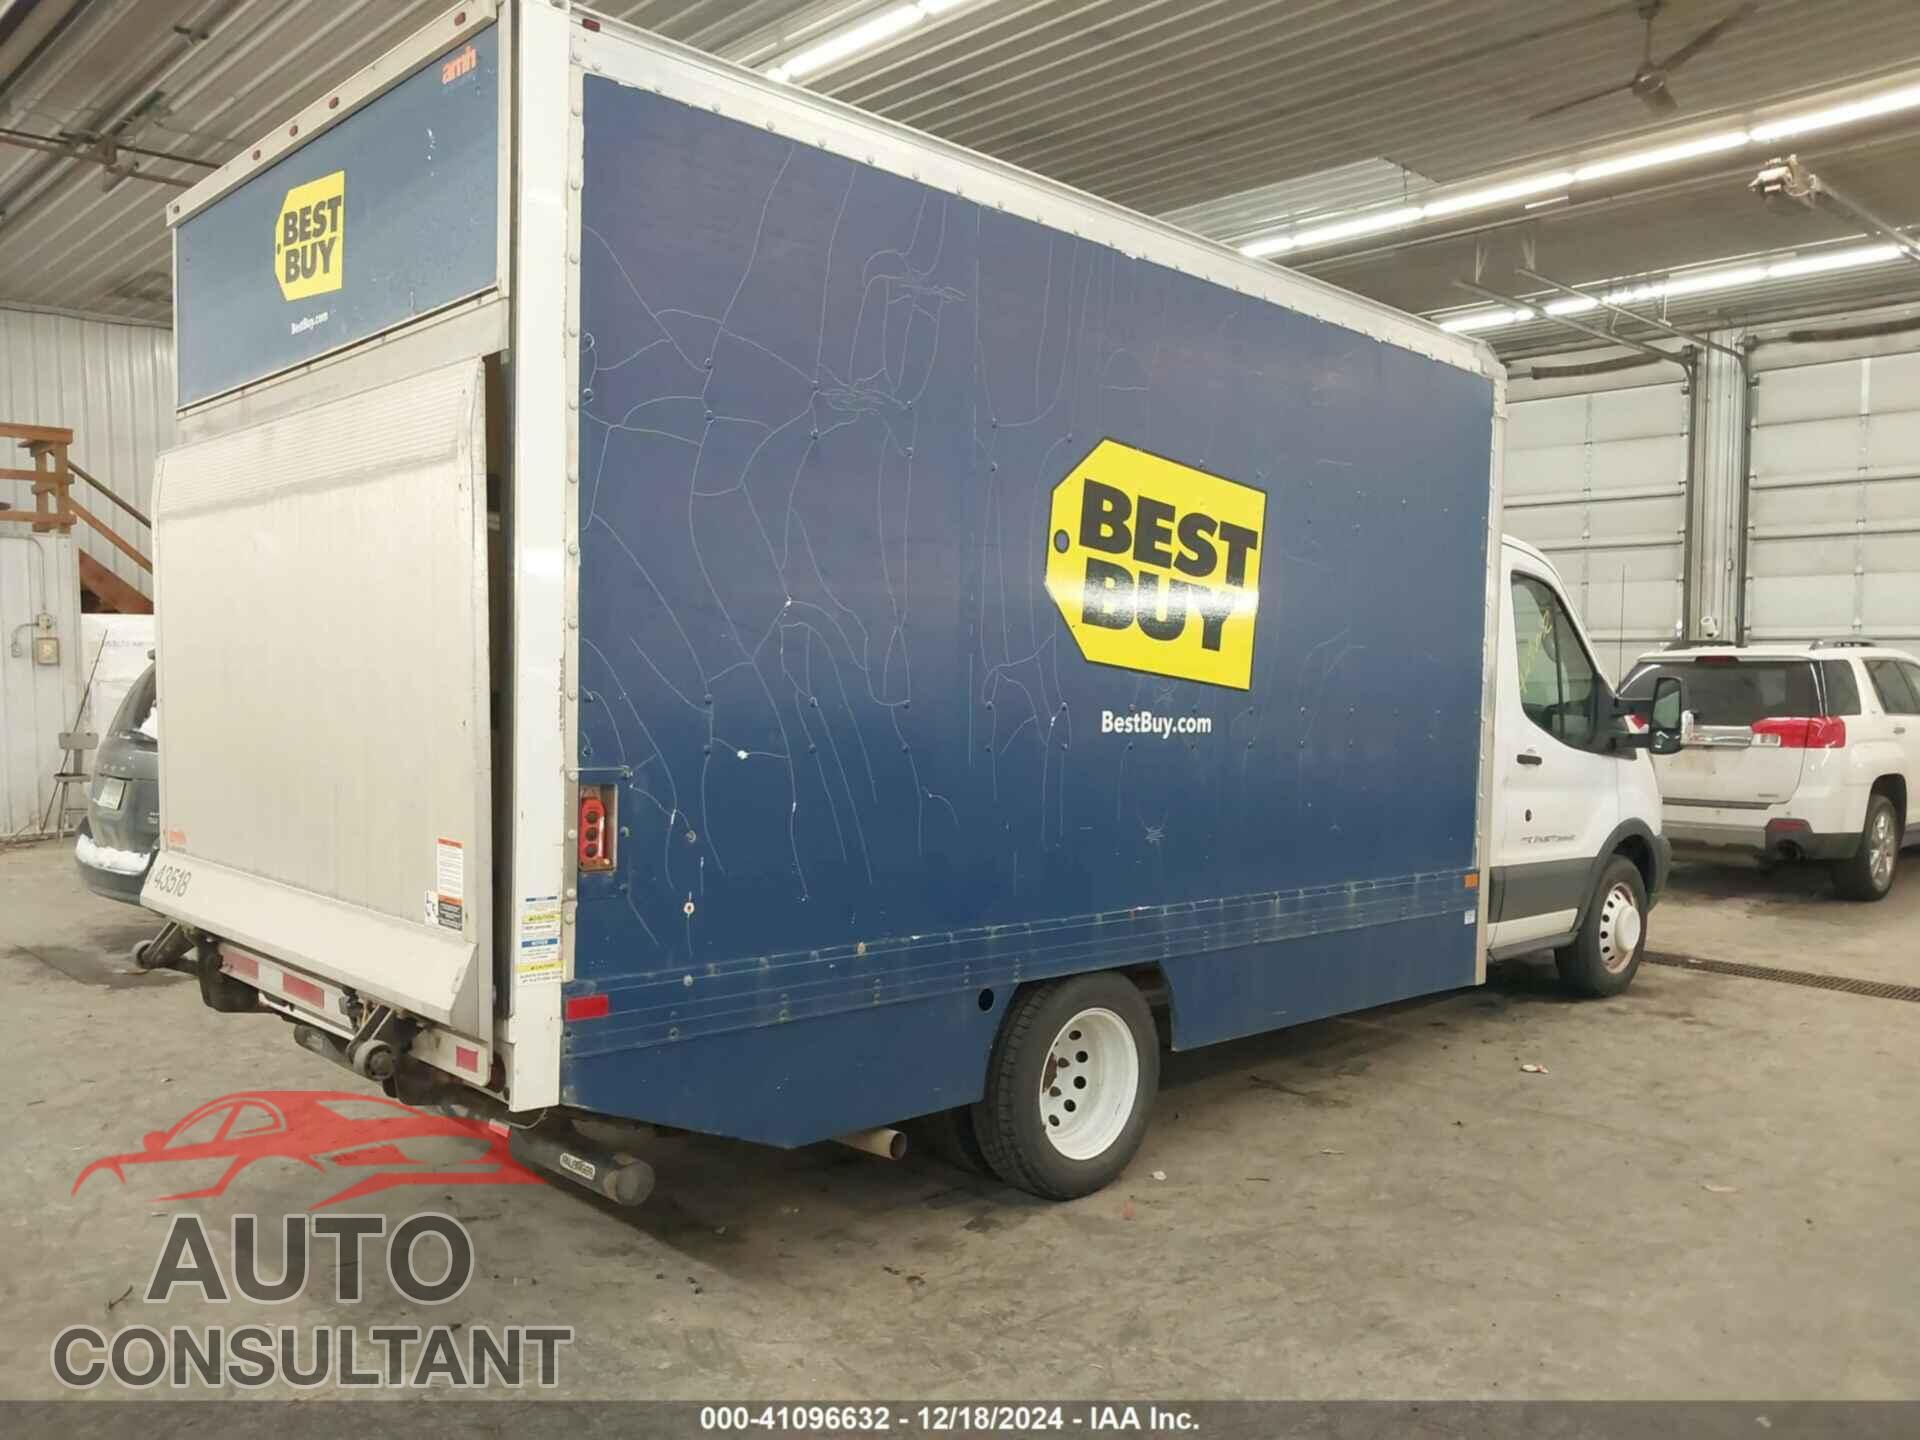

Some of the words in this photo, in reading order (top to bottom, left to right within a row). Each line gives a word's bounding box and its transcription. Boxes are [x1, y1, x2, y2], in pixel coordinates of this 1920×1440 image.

[283, 195, 342, 246] BEST
[285, 236, 337, 284] BUY
[1079, 477, 1258, 588] BEST
[1082, 556, 1232, 652] BUY
[1101, 710, 1212, 739] BestBuy.com
